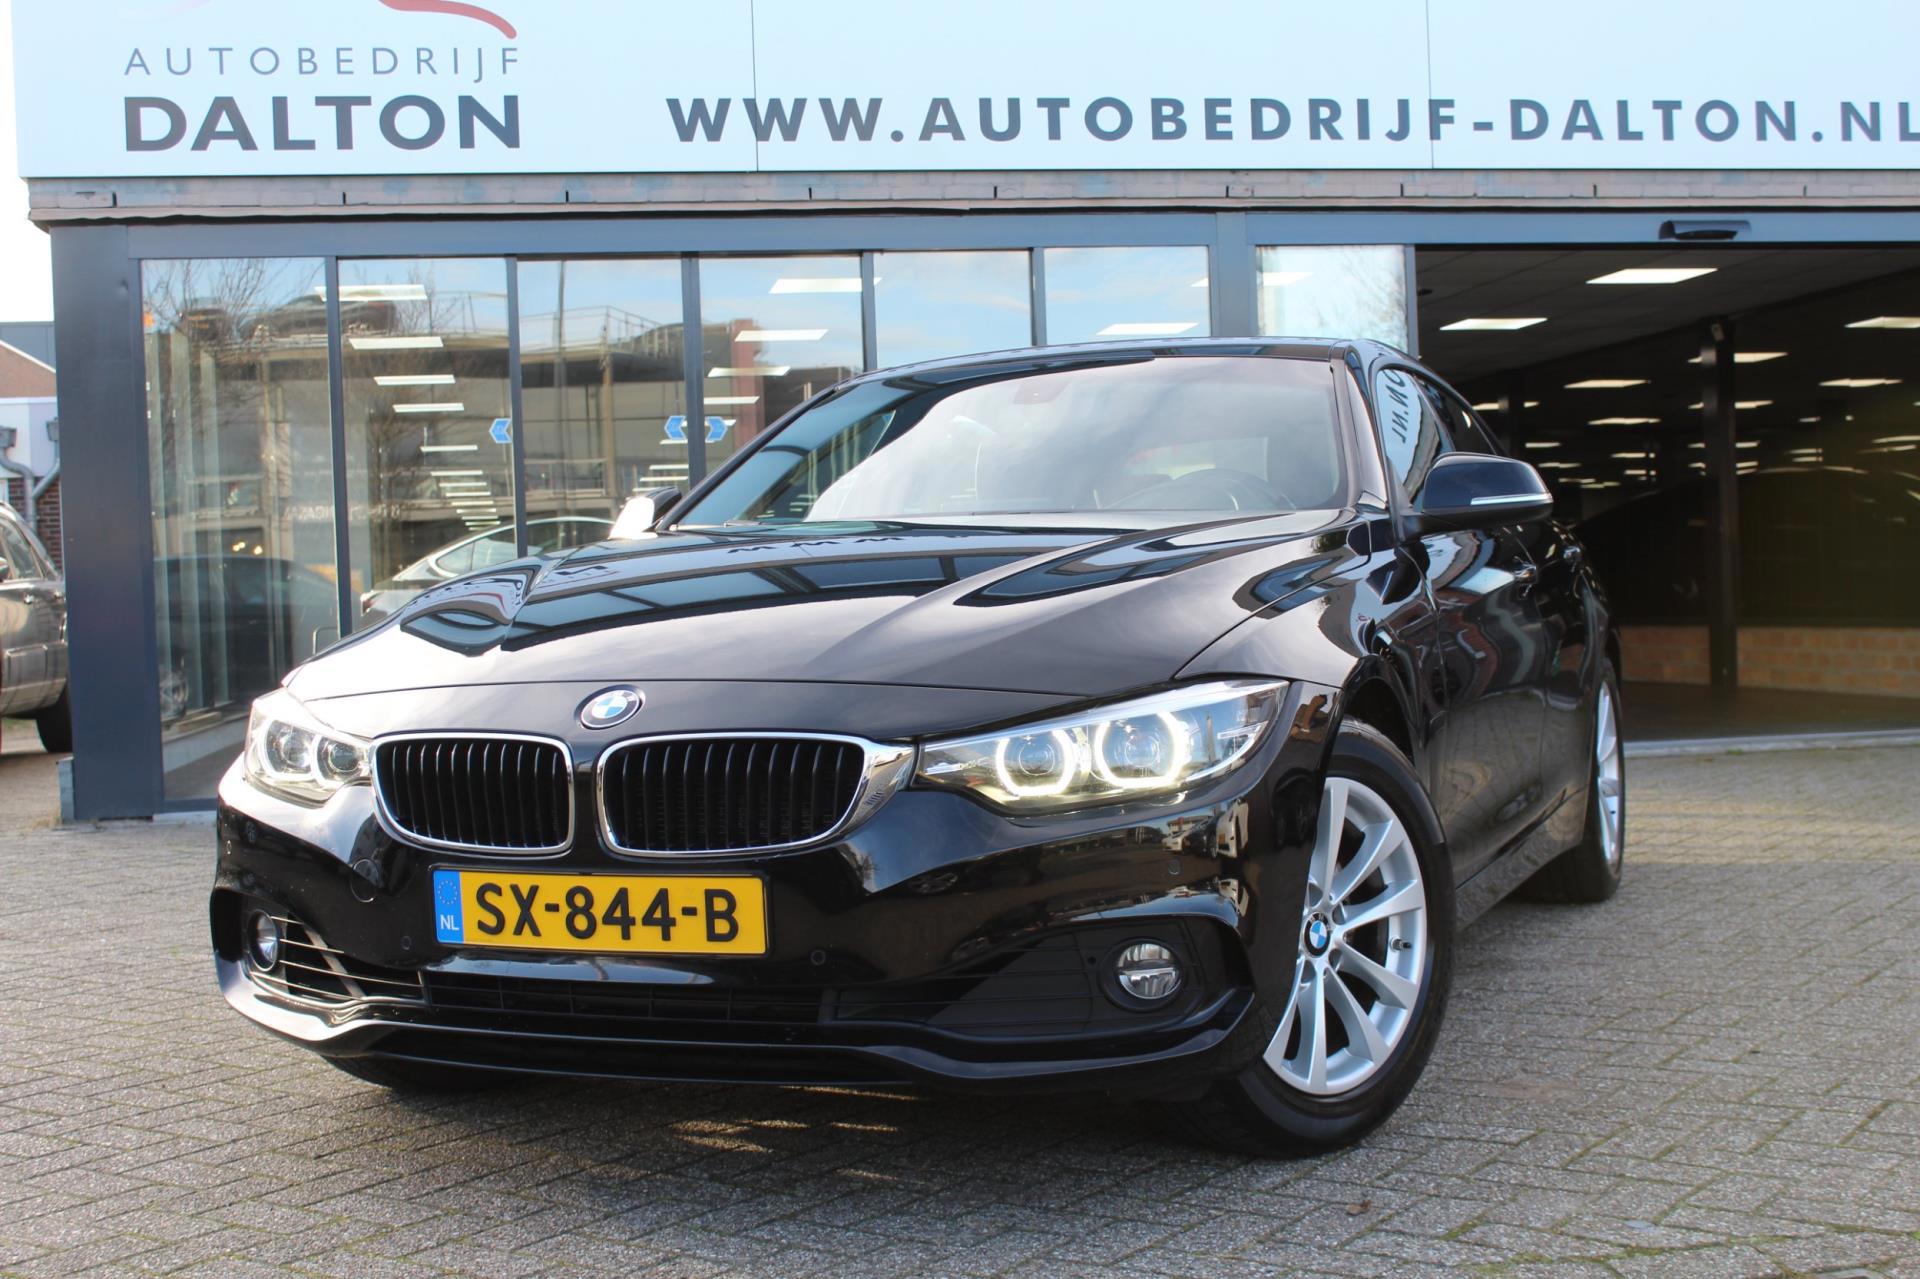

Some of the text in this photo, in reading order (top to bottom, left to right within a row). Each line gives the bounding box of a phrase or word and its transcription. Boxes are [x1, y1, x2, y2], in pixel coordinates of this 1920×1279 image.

[124, 47, 518, 84] AUTOBEDRIJF
[124, 95, 520, 151] DALTON
[666, 97, 1920, 142] WWW.AUTOBEDRIJF-DALTON.NL
[440, 914, 460, 931] NL
[476, 883, 739, 942] SX-844-B
